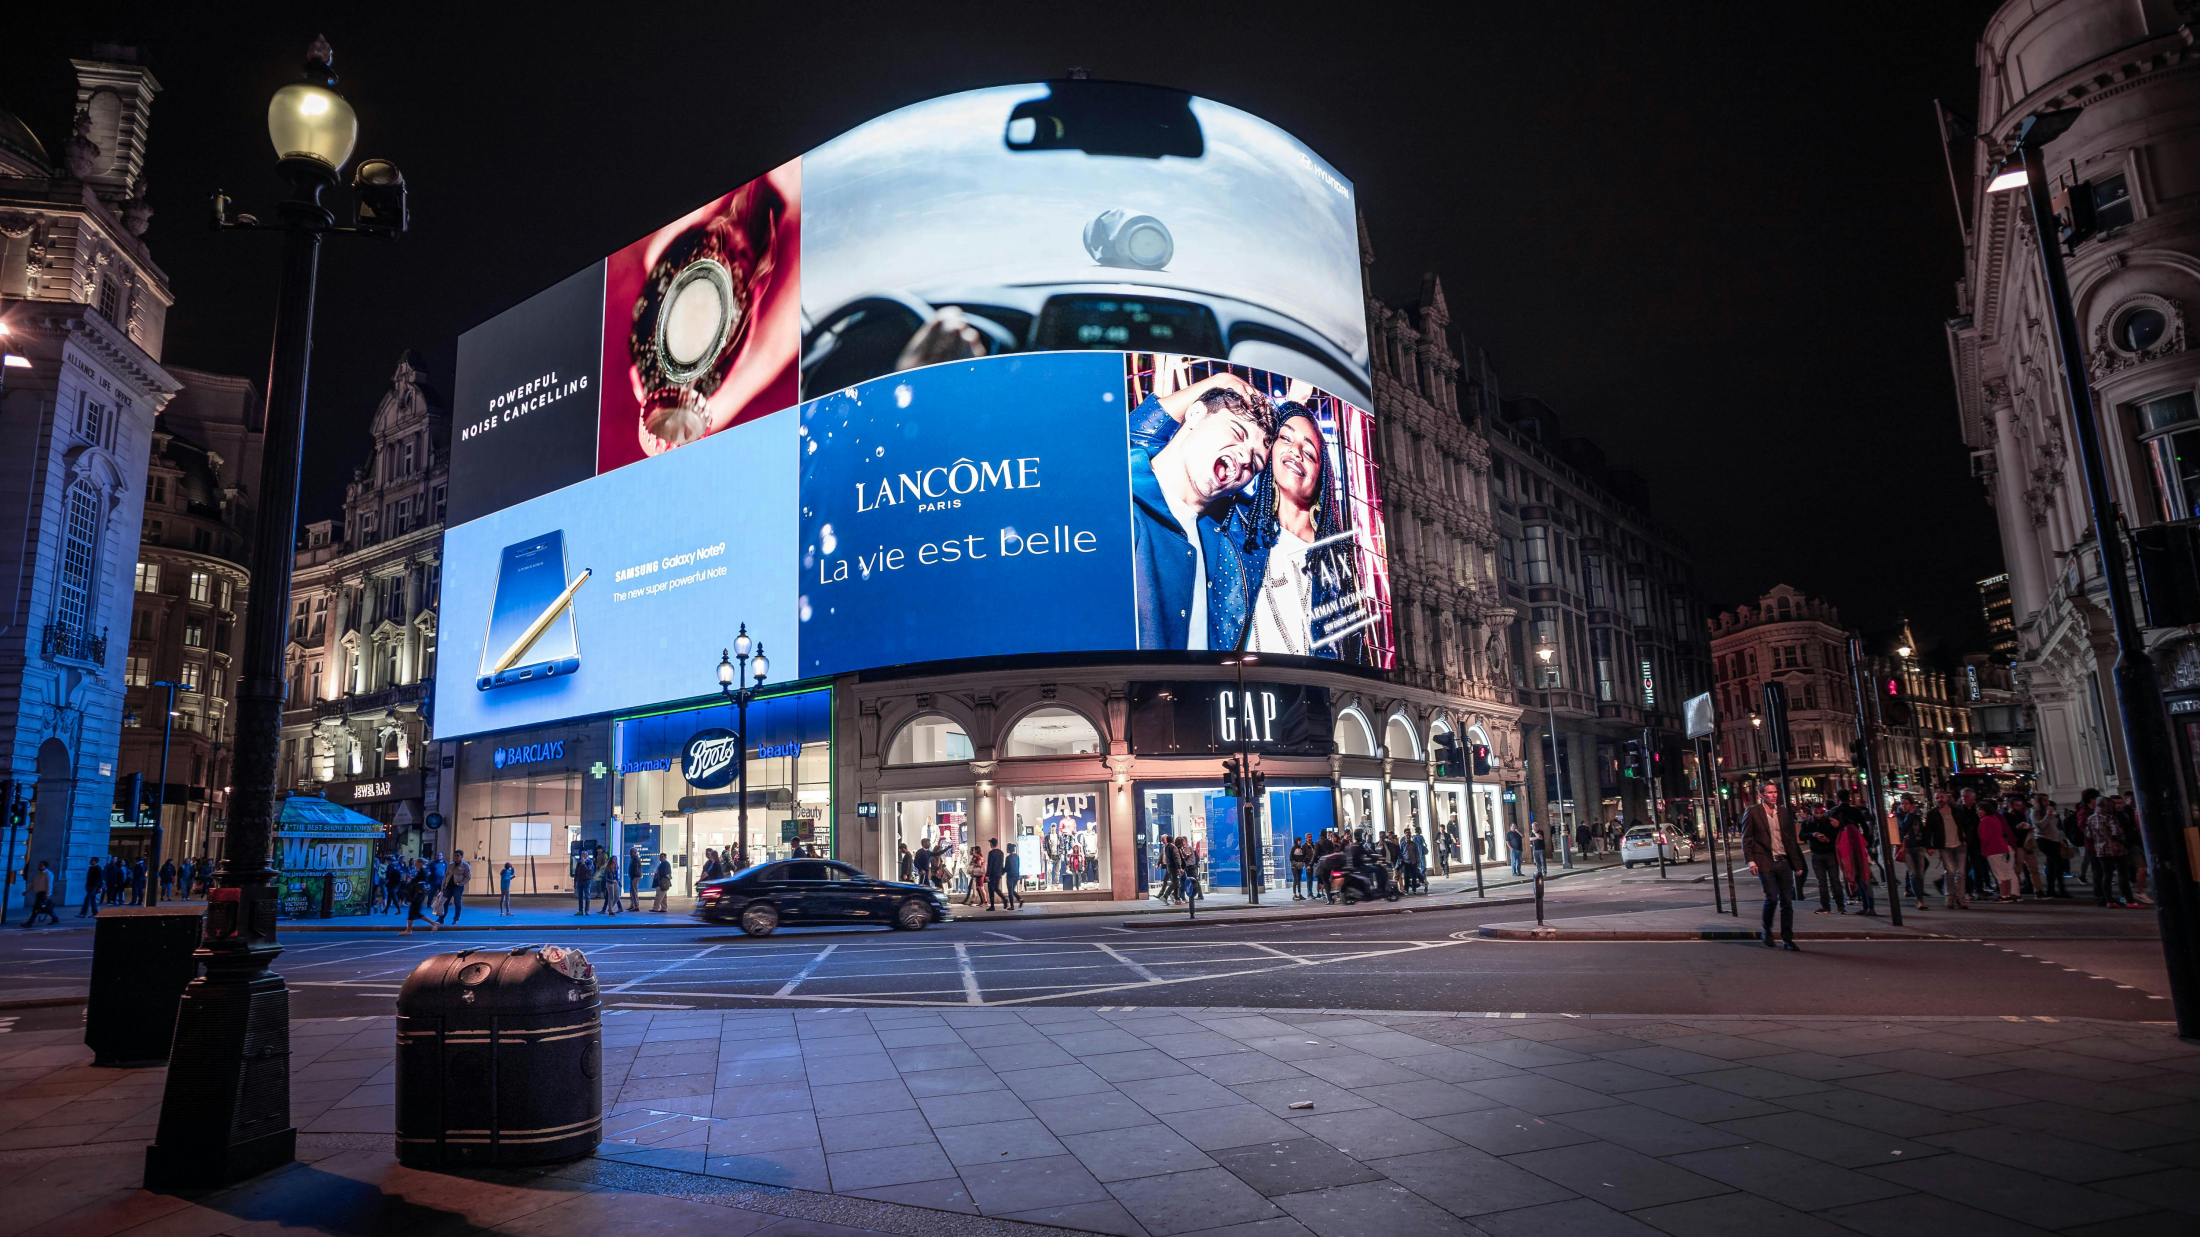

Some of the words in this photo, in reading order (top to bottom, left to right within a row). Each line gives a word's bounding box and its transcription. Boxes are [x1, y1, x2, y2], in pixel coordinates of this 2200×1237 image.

[1313, 163, 1350, 201] HYUNDAI
[67, 352, 96, 381] ALLIANCE
[99, 375, 111, 393] LIFE
[115, 388, 133, 408] OFFICE
[489, 371, 558, 412] POWERFUL
[461, 414, 498, 442] NOISE
[503, 375, 588, 423] CANCELLING
[855, 457, 1041, 513] LANCÔME
[918, 499, 962, 513] PARIS
[615, 560, 659, 583] SAMSUNG
[661, 553, 697, 570] Galaxy
[696, 541, 726, 561] Note9
[820, 558, 849, 585] La
[858, 544, 905, 576] vie
[918, 534, 988, 565] est
[1000, 525, 1097, 557] belle
[612, 592, 627, 603] The
[627, 588, 646, 600] new
[645, 581, 669, 596] super
[669, 569, 706, 592] powerful
[707, 566, 728, 580] Note
[1311, 600, 1339, 620] ARMANI
[1219, 690, 1277, 742] GAP
[507, 740, 566, 765] BARCLAYS
[620, 757, 672, 776] pharmacy
[684, 735, 736, 781] Boots
[757, 740, 803, 761] beauty
[354, 784, 376, 799] JEWEL
[375, 781, 392, 796] BAR
[1043, 796, 1088, 820] GAP
[307, 823, 323, 831] BEST
[334, 882, 348, 893] 00
